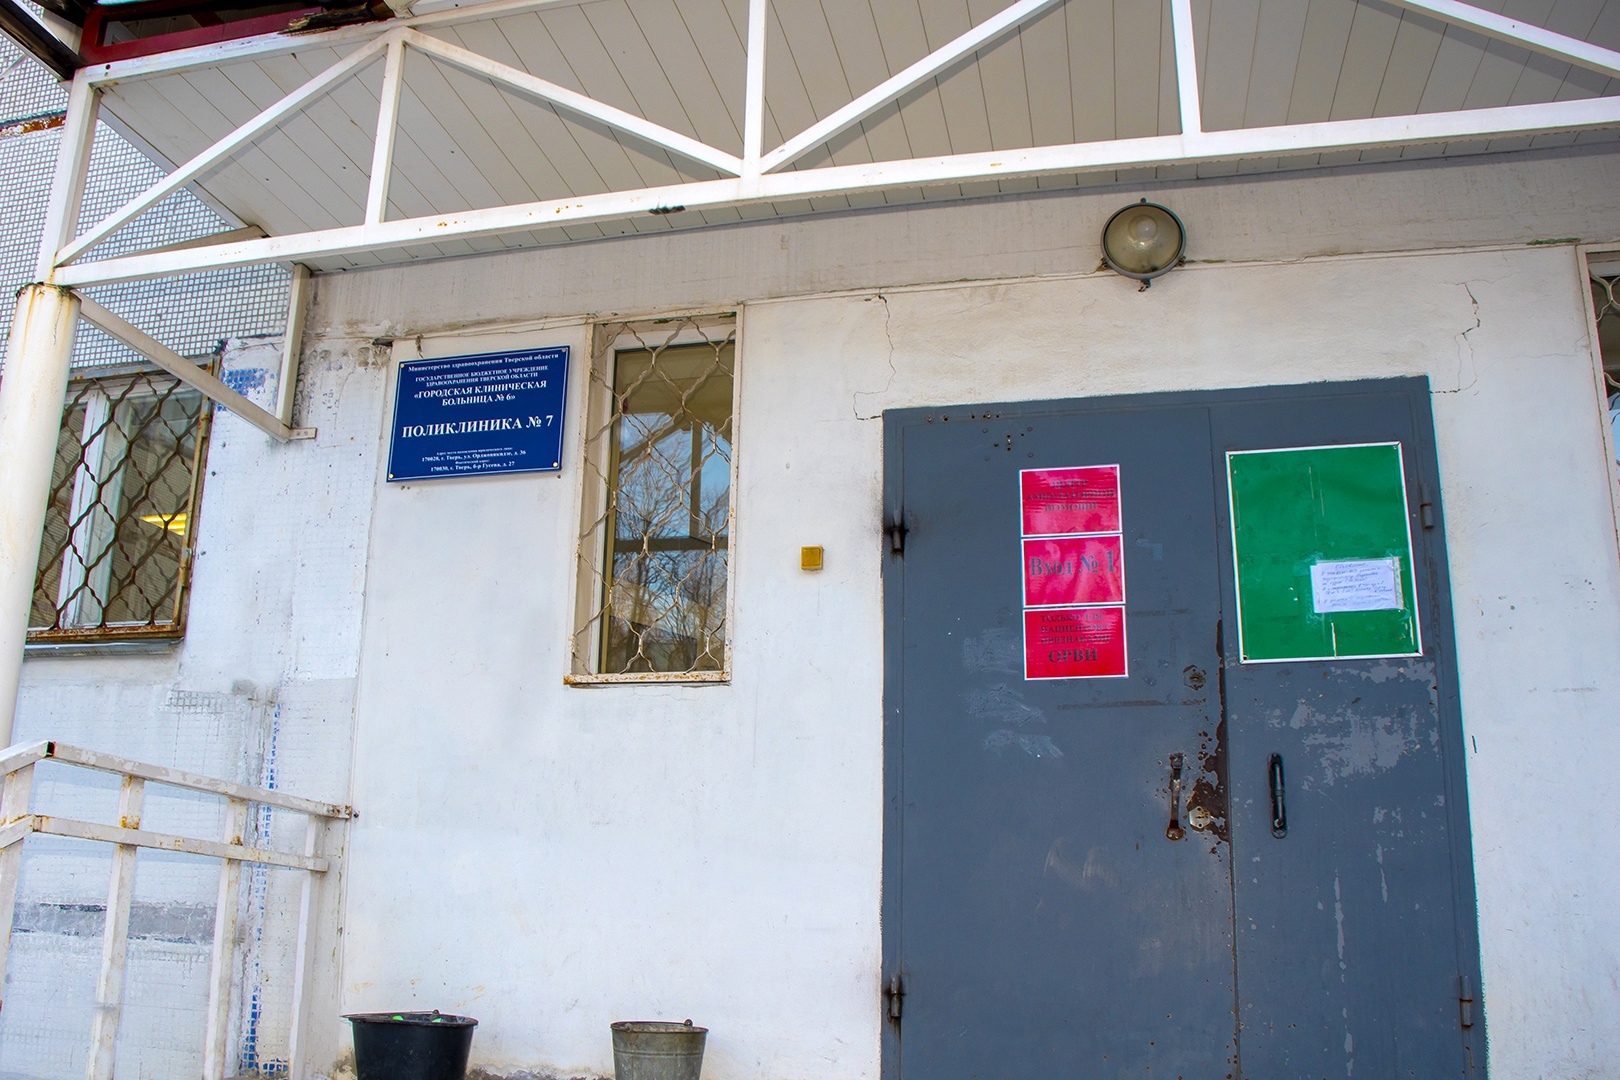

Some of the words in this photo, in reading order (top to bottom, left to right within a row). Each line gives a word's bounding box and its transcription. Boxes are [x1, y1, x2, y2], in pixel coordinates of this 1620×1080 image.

[452, 359, 502, 368] здравоохранения
[504, 355, 533, 364] Тверской
[415, 372, 470, 382] ГОСУДАРСТВЕННОЕ
[470, 368, 508, 378] БЮДЖЕТНОЕ
[508, 365, 548, 374] УЧРЕЖДЕНИЕ
[426, 377, 478, 387] ЗДРАВООХРАНЕНИЯ
[480, 374, 510, 382] ТВЕРСКОЙ
[510, 372, 538, 380] ОБЛАСТИ
[414, 386, 472, 398] «ГОРОДСКАЯ
[474, 380, 547, 394] КЛИНИЧЕСКАЯ
[442, 395, 492, 406] БОЛЬНИЦА
[494, 394, 504, 402] №
[506, 392, 516, 400] 6»
[402, 418, 522, 438] ПОЛИКЛИНИКА
[526, 416, 542, 428] №
[546, 414, 554, 427] 7
[1031, 558, 1072, 576] Вход
[1078, 554, 1098, 573] №
[1106, 550, 1114, 572] 1
[1048, 648, 1098, 663] ОРВИ
